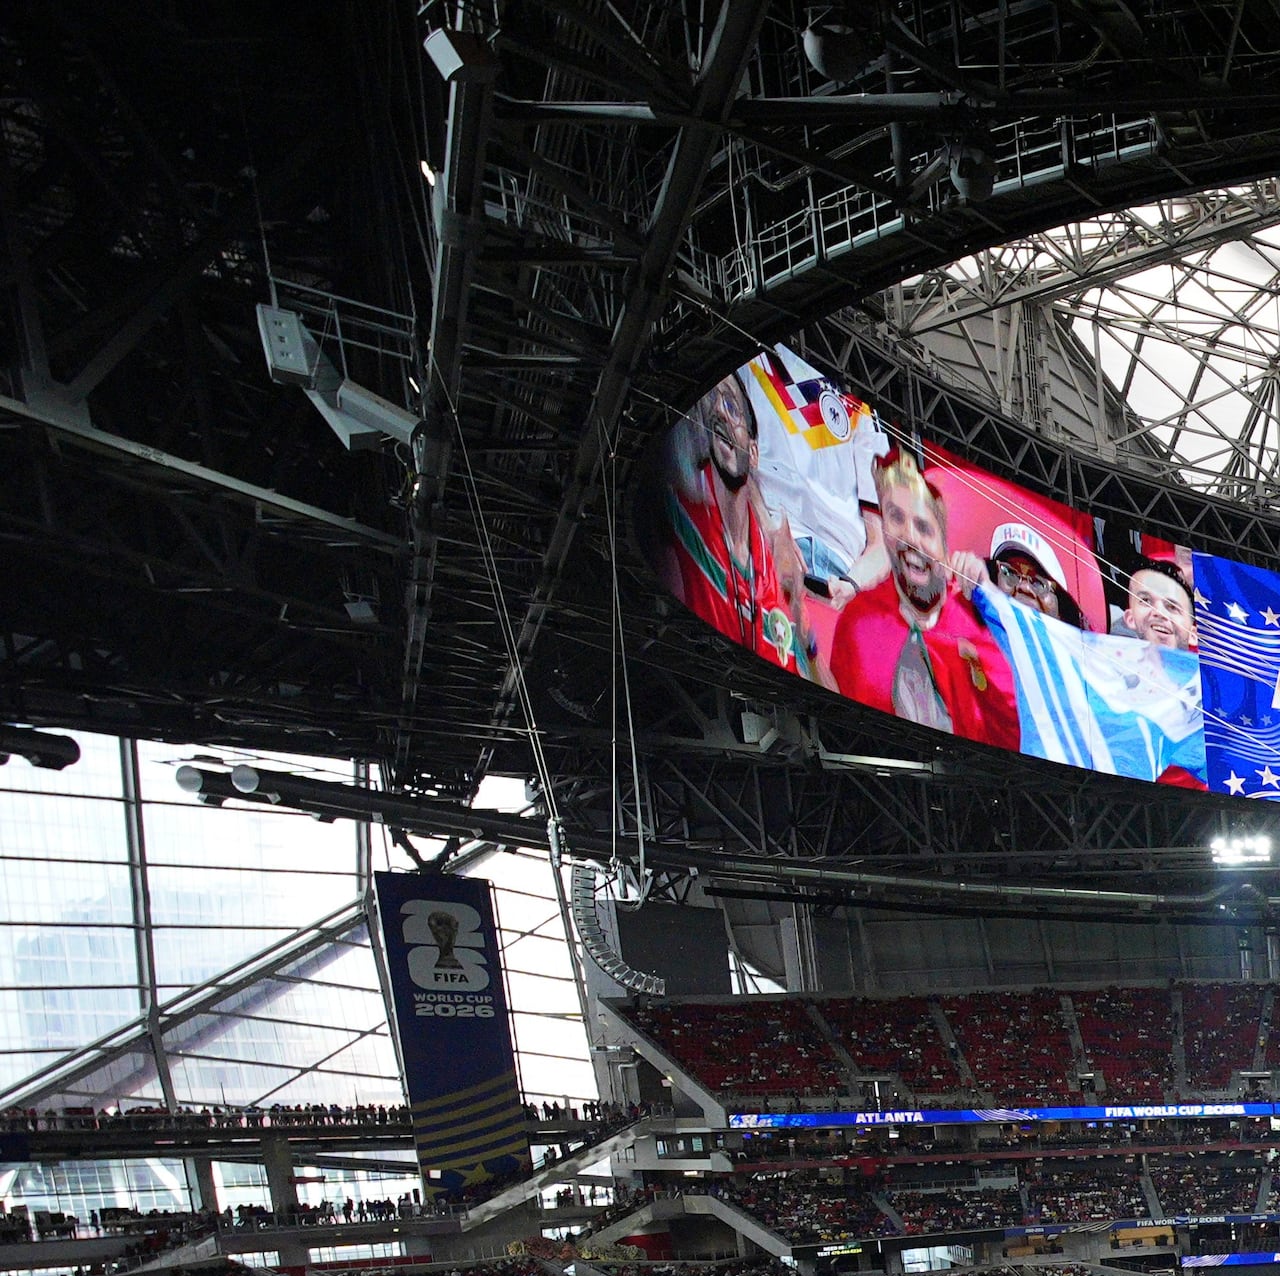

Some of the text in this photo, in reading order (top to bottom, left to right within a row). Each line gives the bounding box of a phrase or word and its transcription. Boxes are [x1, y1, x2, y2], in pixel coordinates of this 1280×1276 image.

[1003, 526, 1040, 551] HAITI
[434, 972, 469, 983] FIFA
[413, 992, 493, 1004] WORLD CUP
[415, 1003, 495, 1018] 2026
[1105, 1105, 1246, 1117] FIFA WORLD CUP 2026
[855, 1111, 924, 1124] ATLANTA
